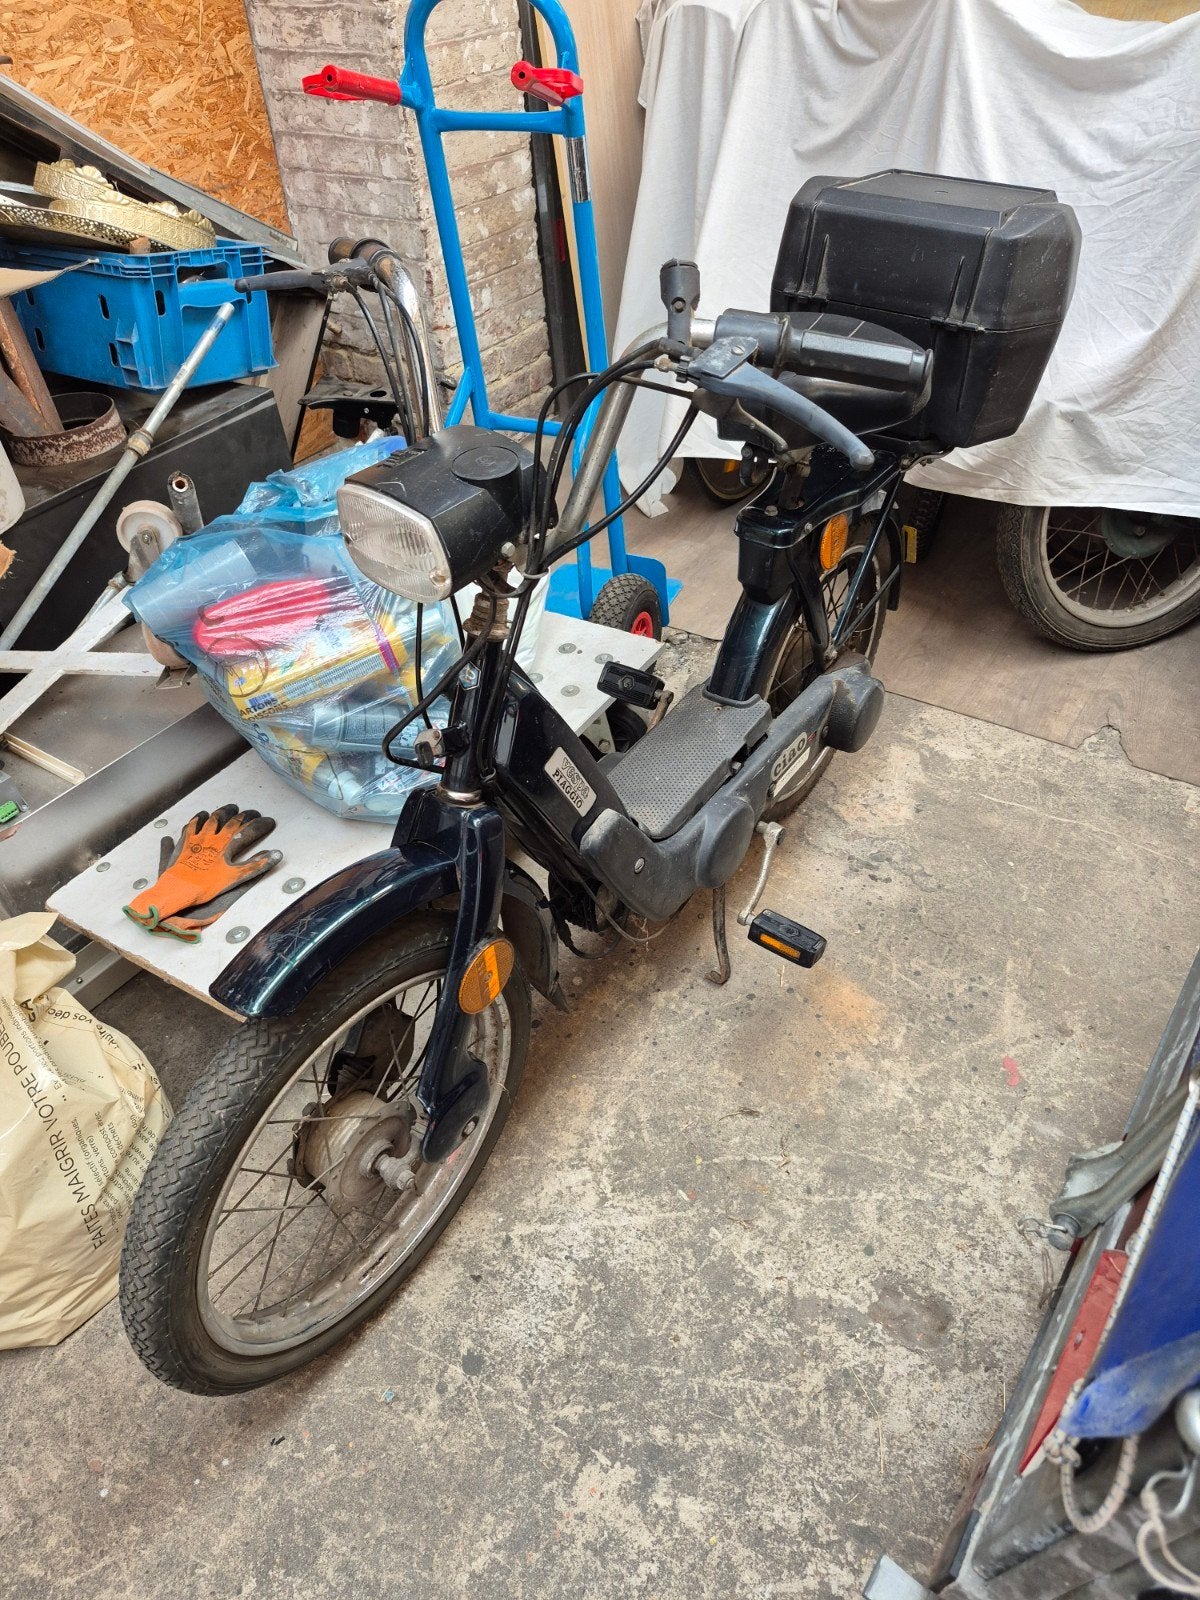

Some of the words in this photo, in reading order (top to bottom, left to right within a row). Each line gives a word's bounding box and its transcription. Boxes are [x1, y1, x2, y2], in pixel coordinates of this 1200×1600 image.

[552, 769, 583, 809] PIAGGIO
[72, 1012, 93, 1025] vos
[20, 1074, 59, 1131] VOTRE
[50, 1131, 89, 1203] MAIGRIR
[80, 1204, 108, 1250] FAITES
